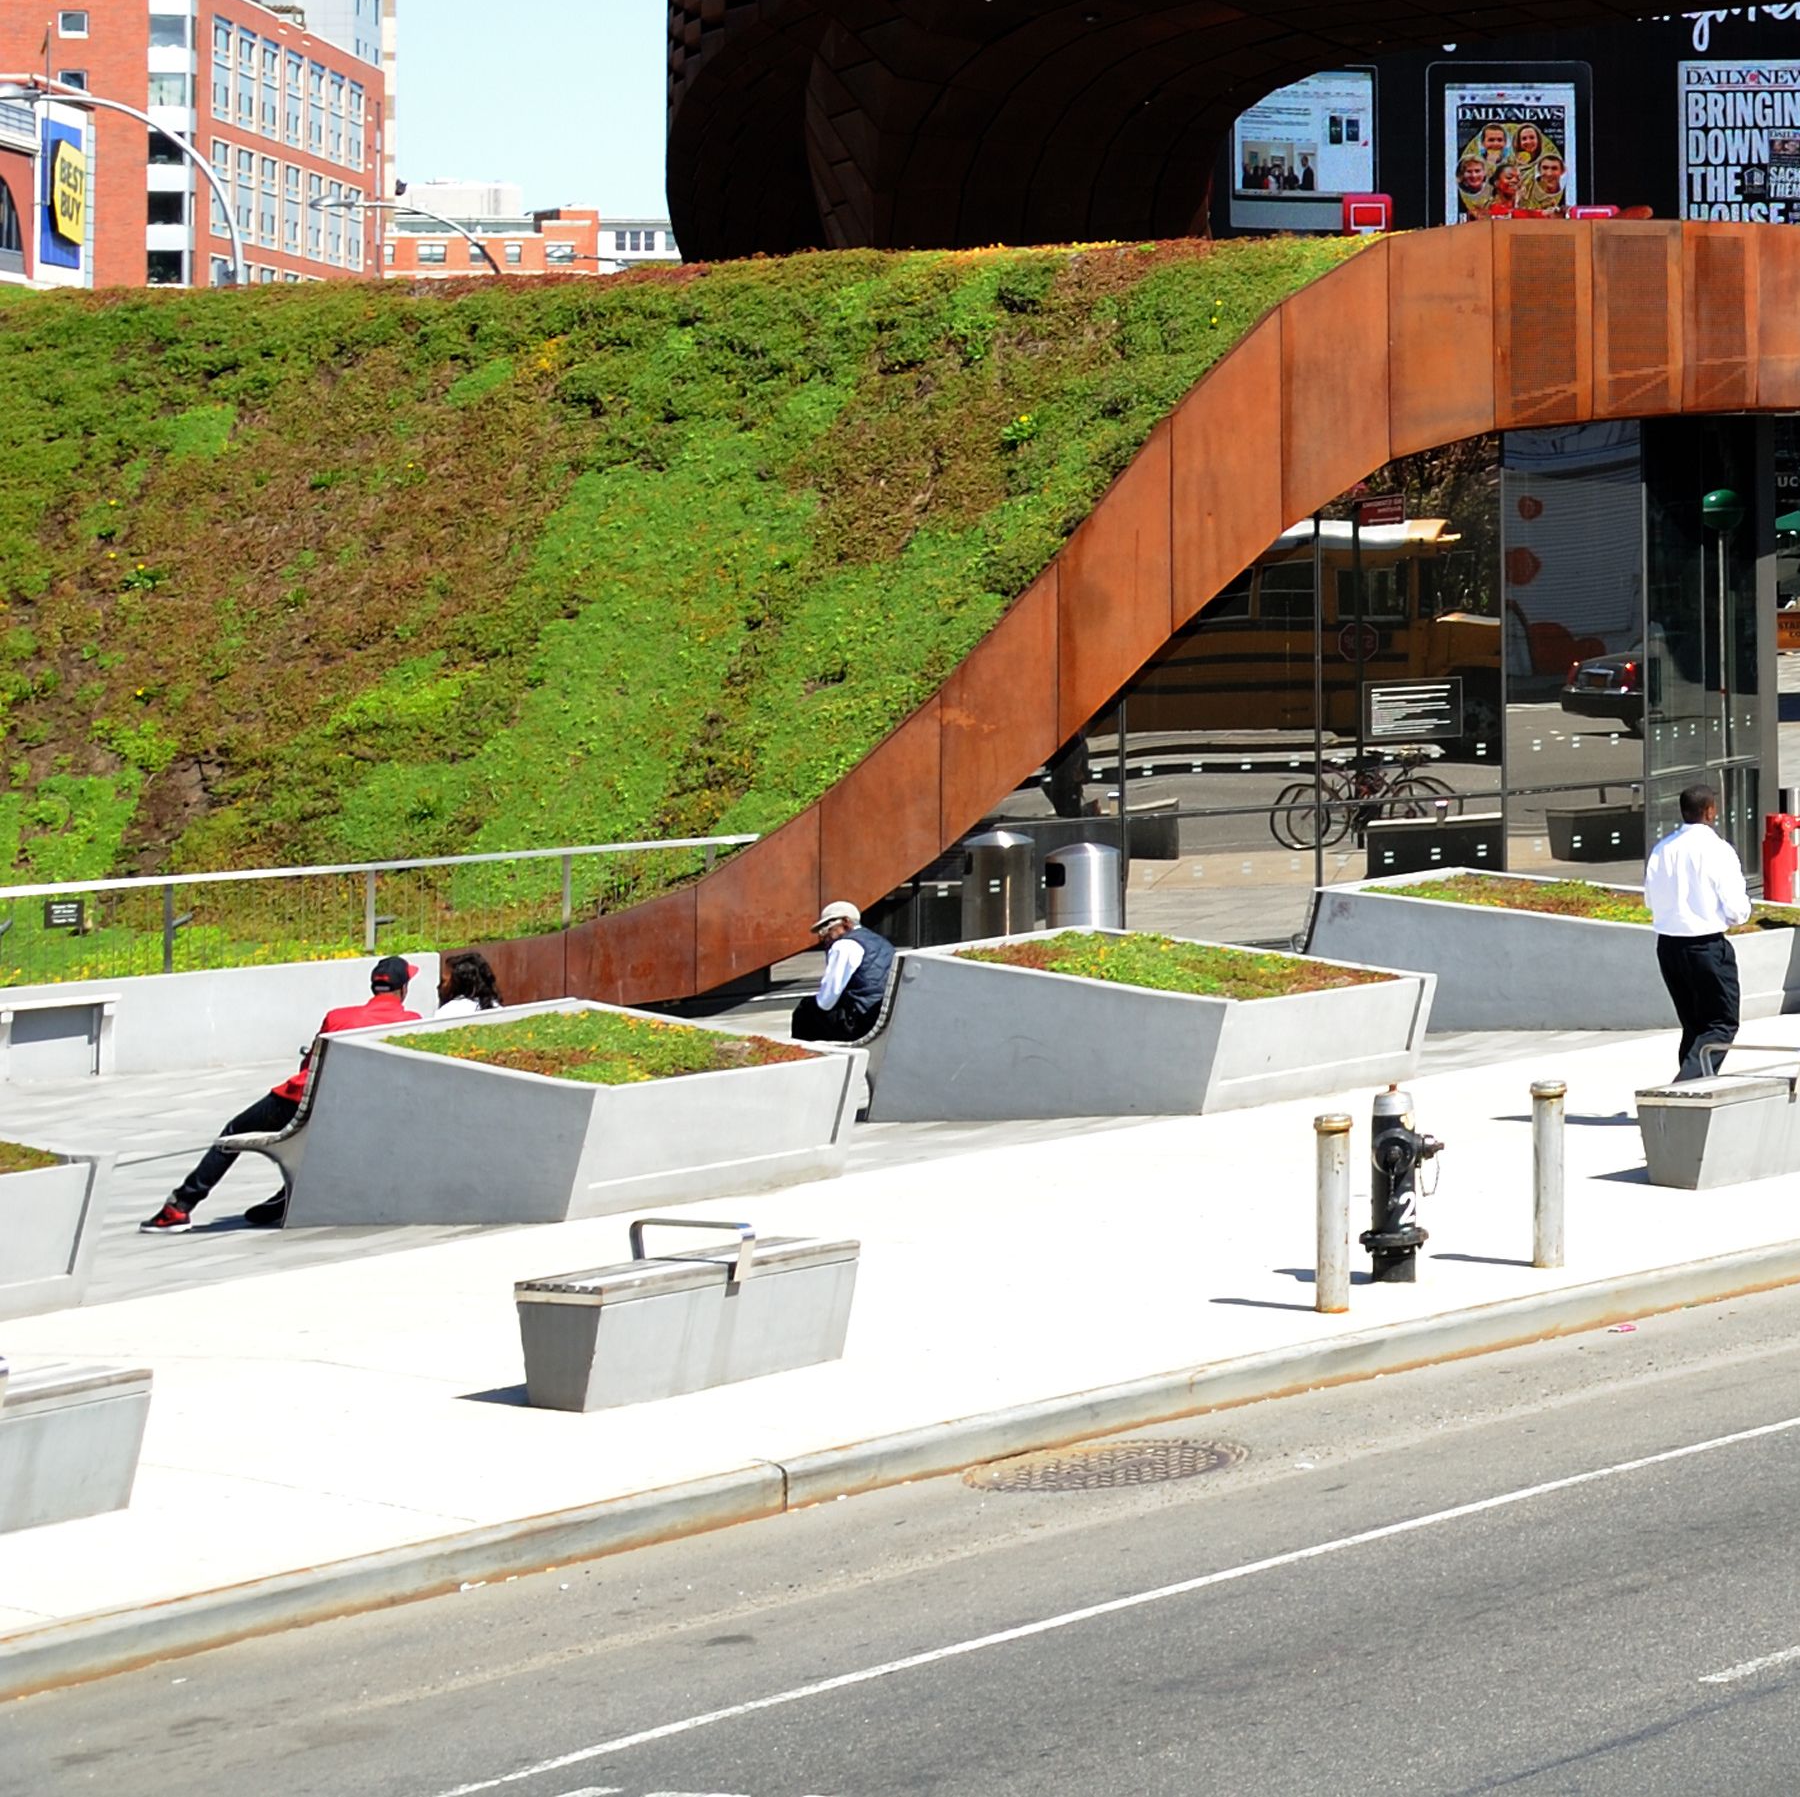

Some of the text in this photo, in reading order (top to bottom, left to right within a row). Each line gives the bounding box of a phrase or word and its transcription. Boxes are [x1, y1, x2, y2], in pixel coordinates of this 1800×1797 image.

[1686, 70, 1752, 85] DAILY
[1458, 107, 1565, 121] DAILY NEWS
[1688, 128, 1770, 165] DOWN
[60, 156, 84, 193] BEST
[1688, 166, 1744, 202] THE
[60, 192, 82, 226] BUY
[1398, 1191, 1416, 1225] 2
